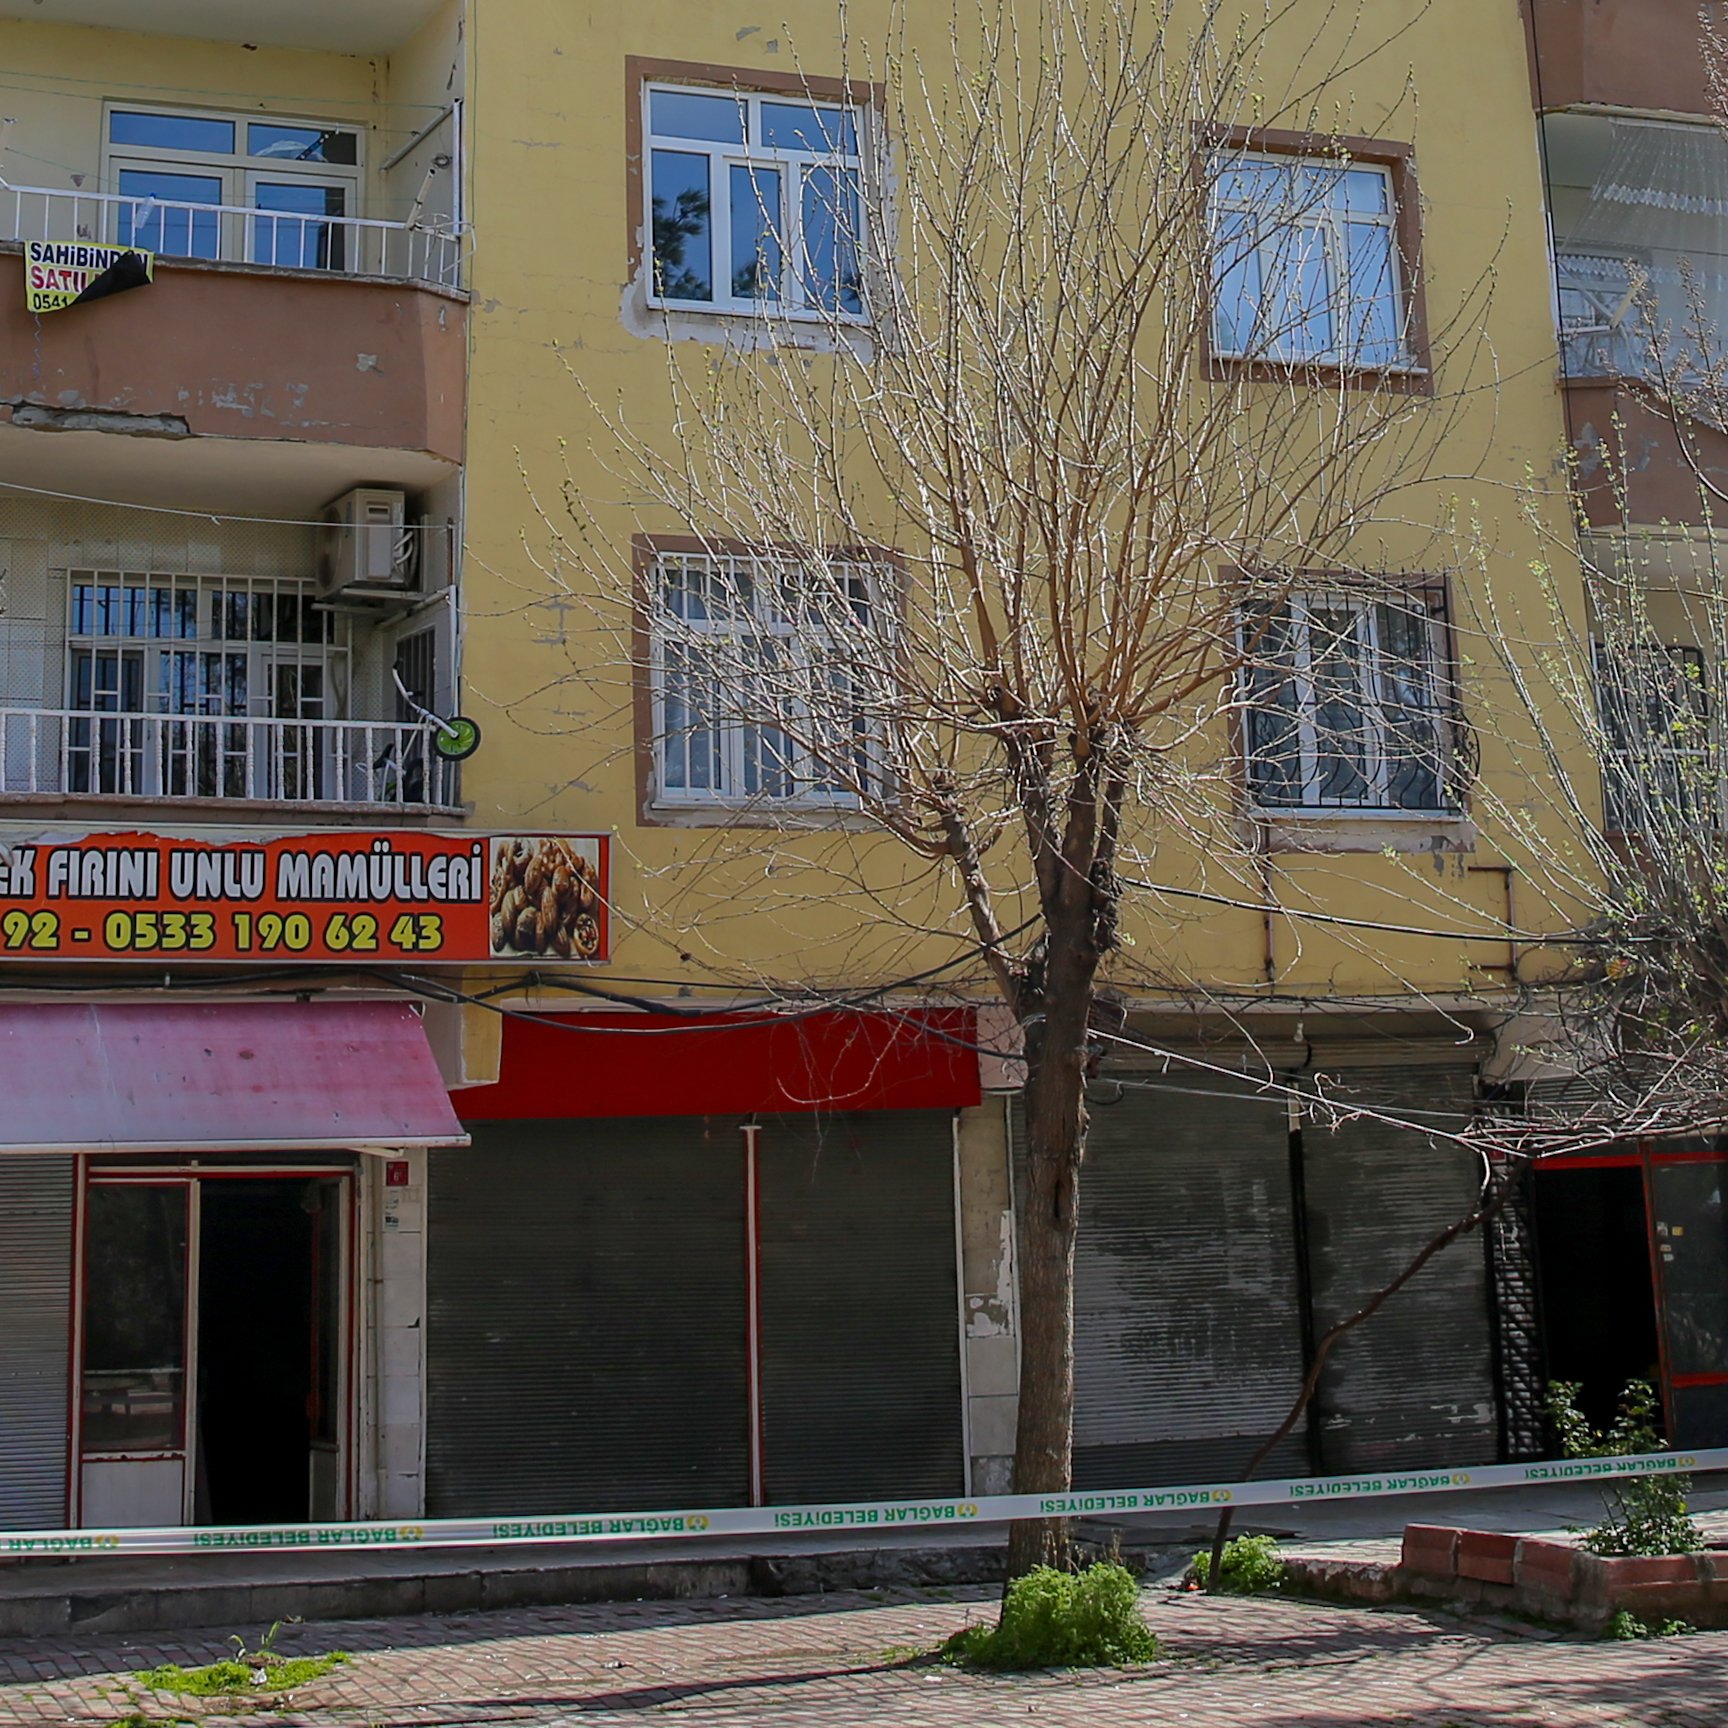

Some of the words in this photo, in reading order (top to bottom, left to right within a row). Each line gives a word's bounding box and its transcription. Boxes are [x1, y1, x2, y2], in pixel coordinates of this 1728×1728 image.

[46, 849, 158, 898] FIRINI
[170, 852, 265, 899] UNLU
[2, 910, 59, 949] 92
[104, 912, 216, 950] 0533
[233, 912, 310, 950] 190
[324, 913, 378, 950] 62
[389, 913, 444, 950] 43
